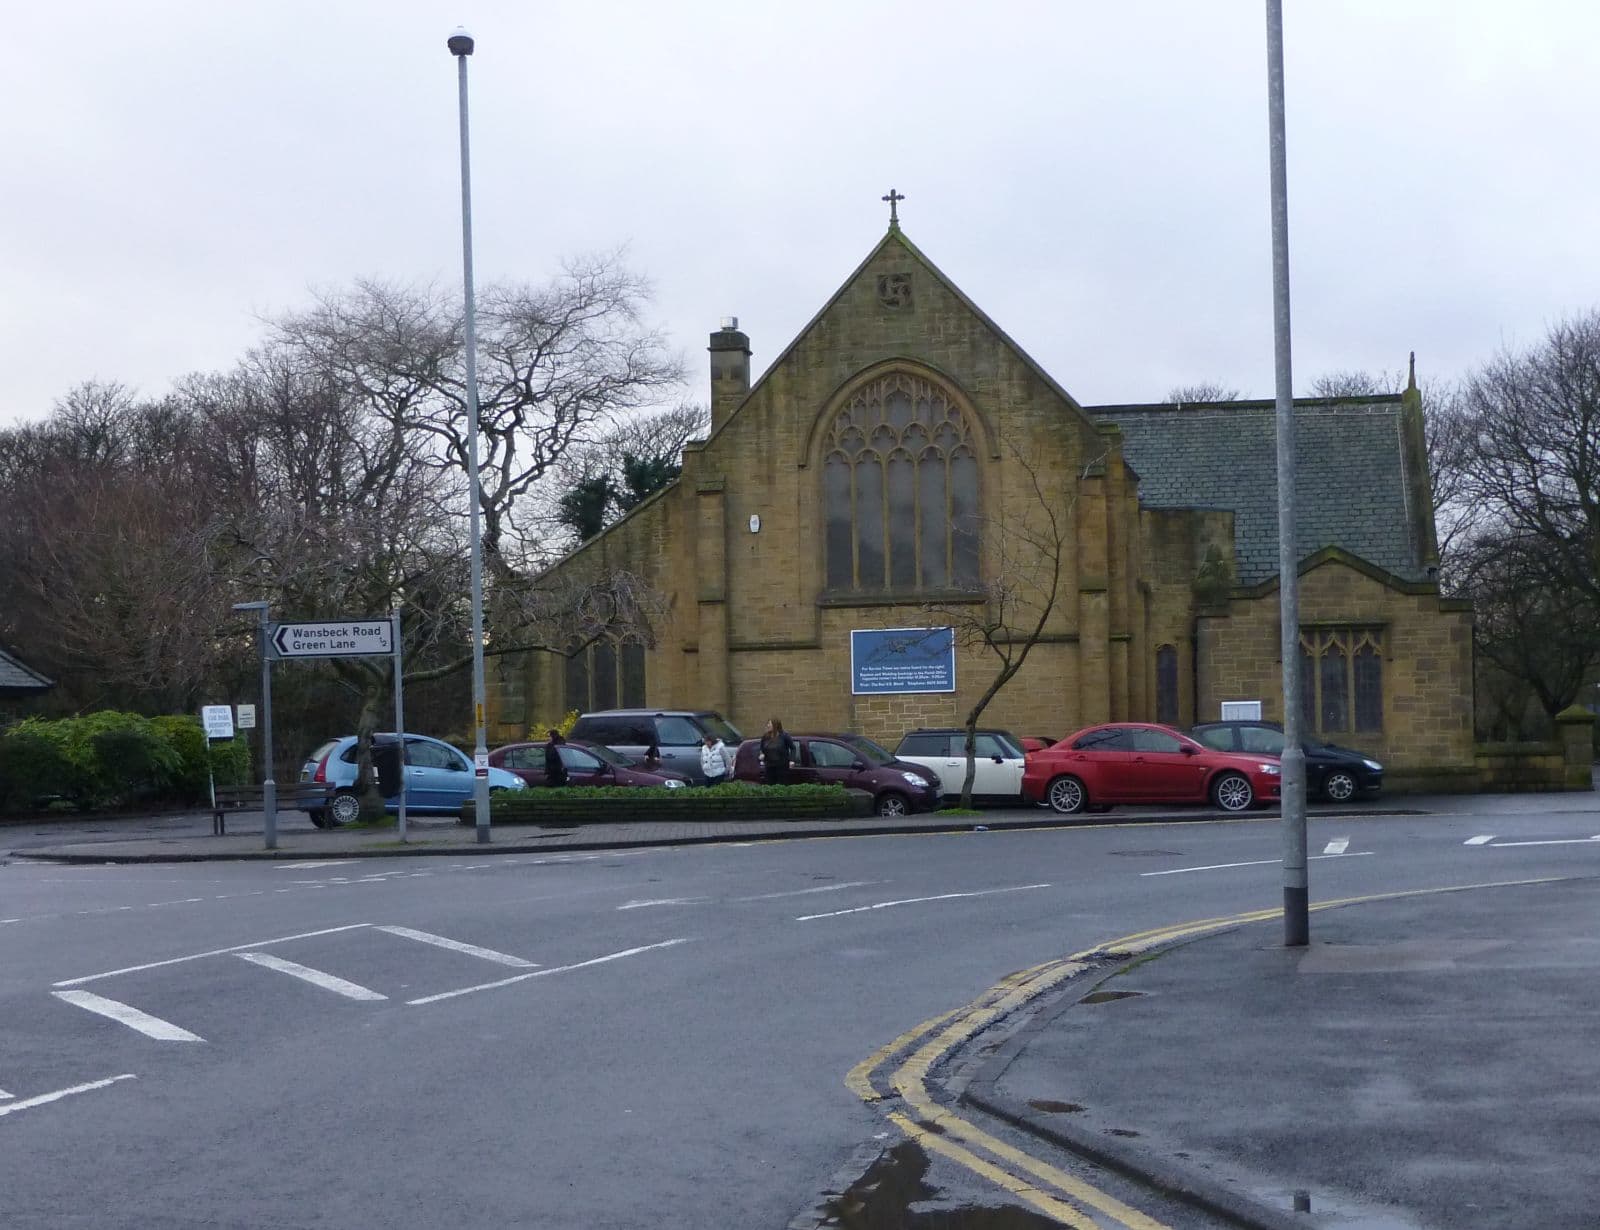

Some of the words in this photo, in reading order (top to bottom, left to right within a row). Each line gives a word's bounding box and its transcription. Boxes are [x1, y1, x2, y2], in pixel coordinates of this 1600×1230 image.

[293, 627, 348, 638] Wansbeck
[352, 626, 381, 636] Road
[293, 640, 326, 650] Green
[330, 639, 356, 649] Lane
